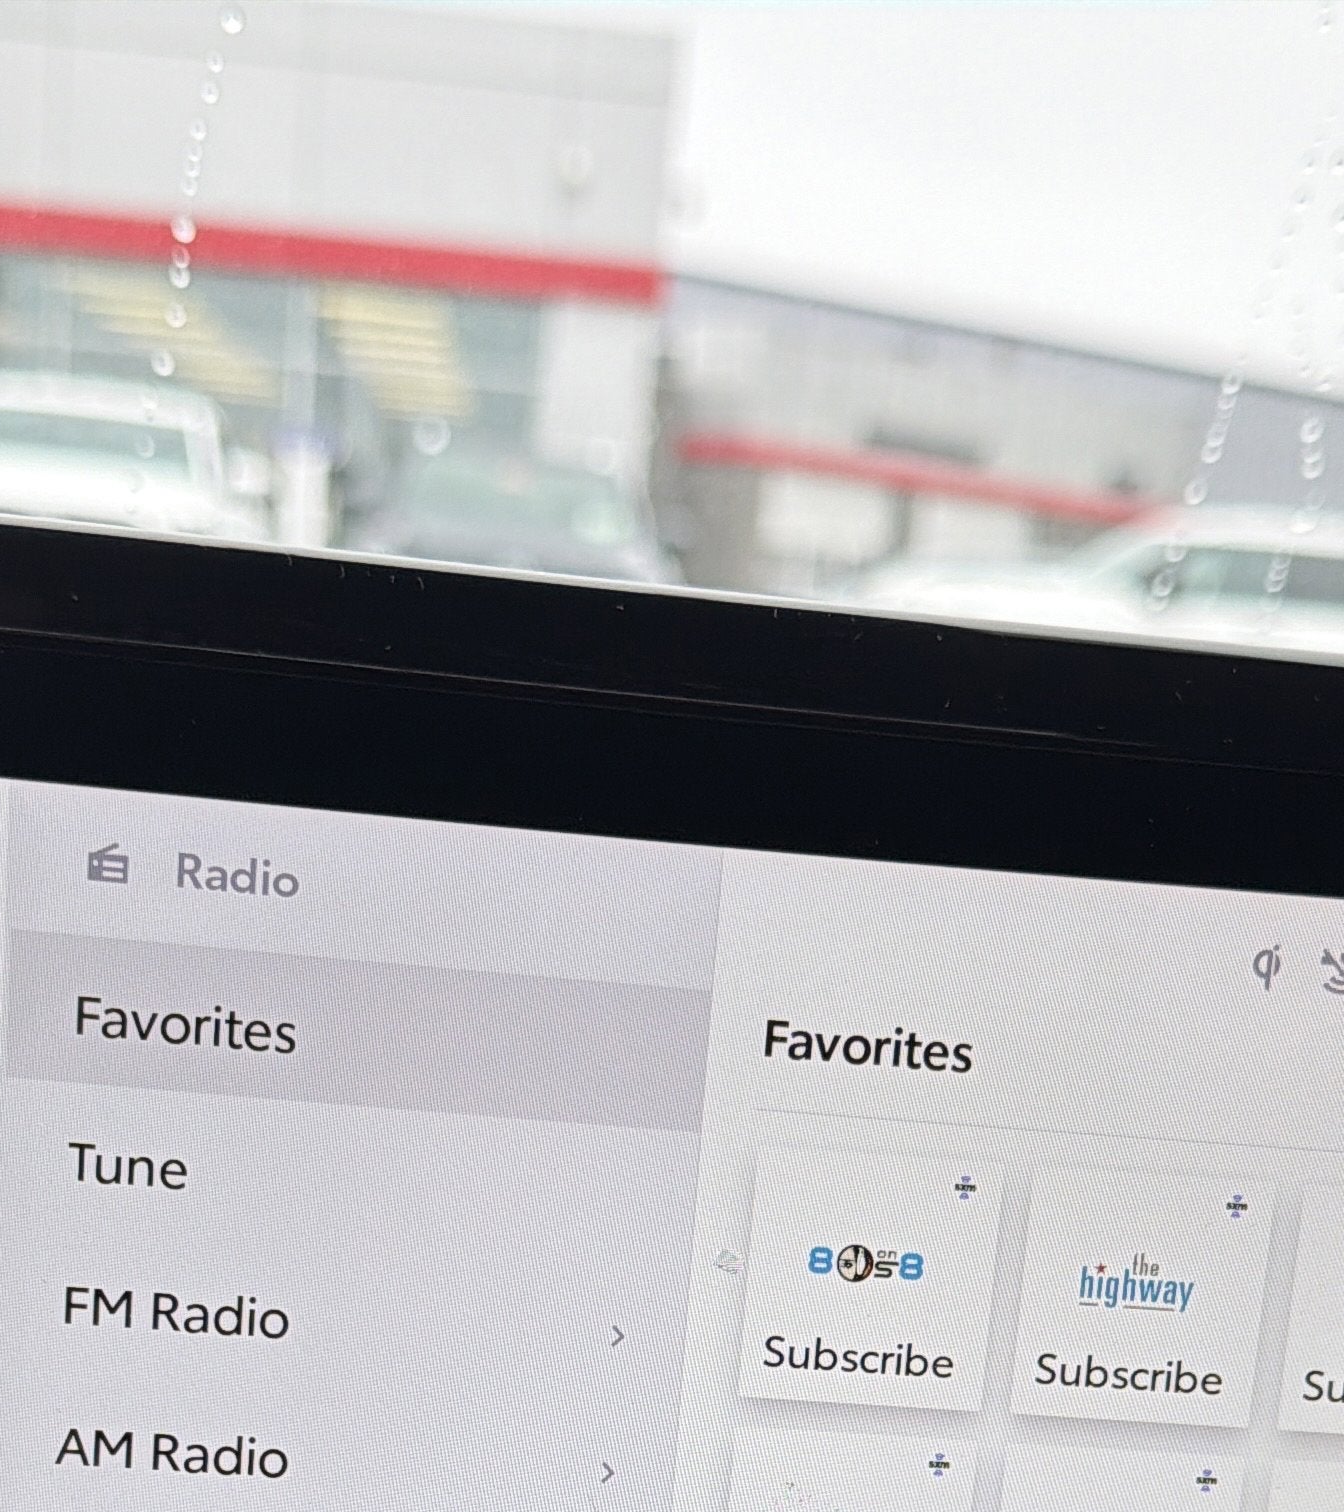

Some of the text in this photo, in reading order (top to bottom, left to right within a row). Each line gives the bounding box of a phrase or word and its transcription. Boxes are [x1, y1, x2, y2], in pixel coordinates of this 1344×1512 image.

[176, 852, 301, 900] Radio
[75, 997, 298, 1054] Favorites
[763, 1019, 974, 1075] Favorites
[68, 1143, 189, 1191] Tune
[1132, 1253, 1160, 1276] the
[1079, 1265, 1194, 1313] highway
[63, 1286, 290, 1341] FM Radio
[763, 1335, 954, 1378] Subscribe
[1035, 1353, 1223, 1395] Subscribe
[55, 1429, 289, 1480] AM Radio
